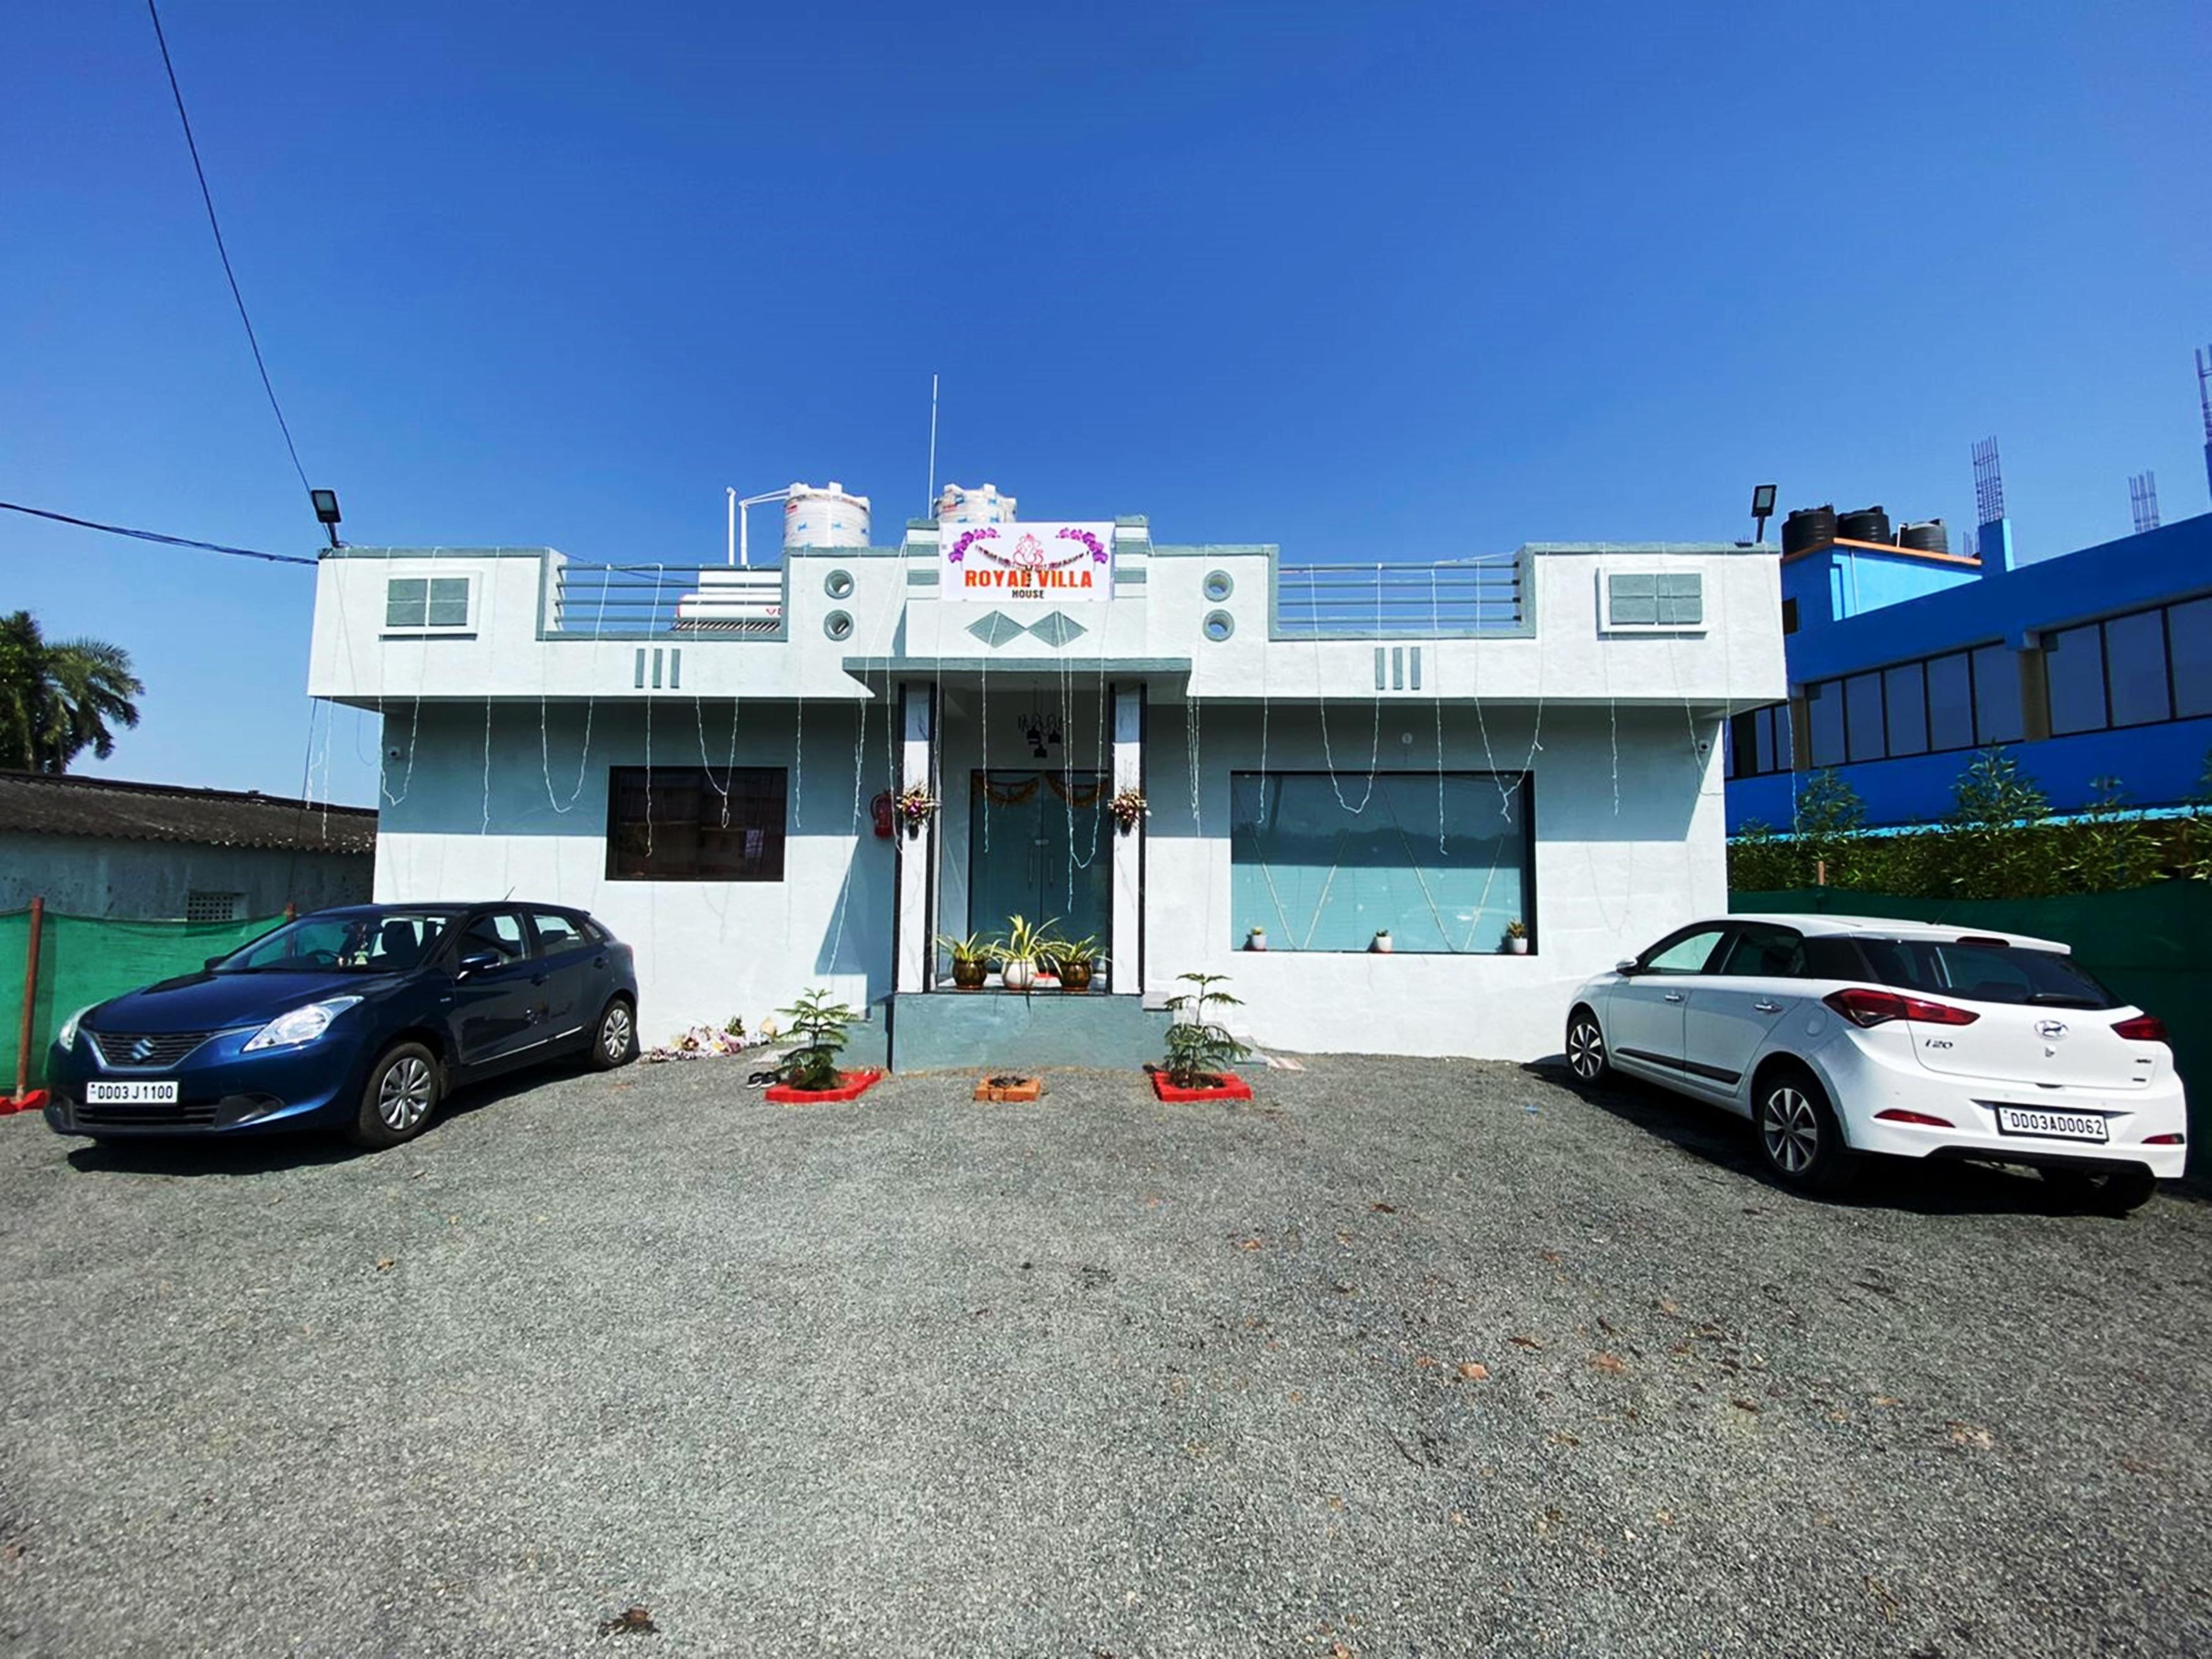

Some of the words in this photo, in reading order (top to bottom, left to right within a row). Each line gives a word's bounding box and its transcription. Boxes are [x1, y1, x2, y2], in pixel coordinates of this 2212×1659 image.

[964, 570, 1031, 588] ROYAL
[1038, 570, 1092, 588] VILLA
[1012, 590, 1044, 599] HOUSE
[2010, 1112, 2104, 1135] DD03AD0062
